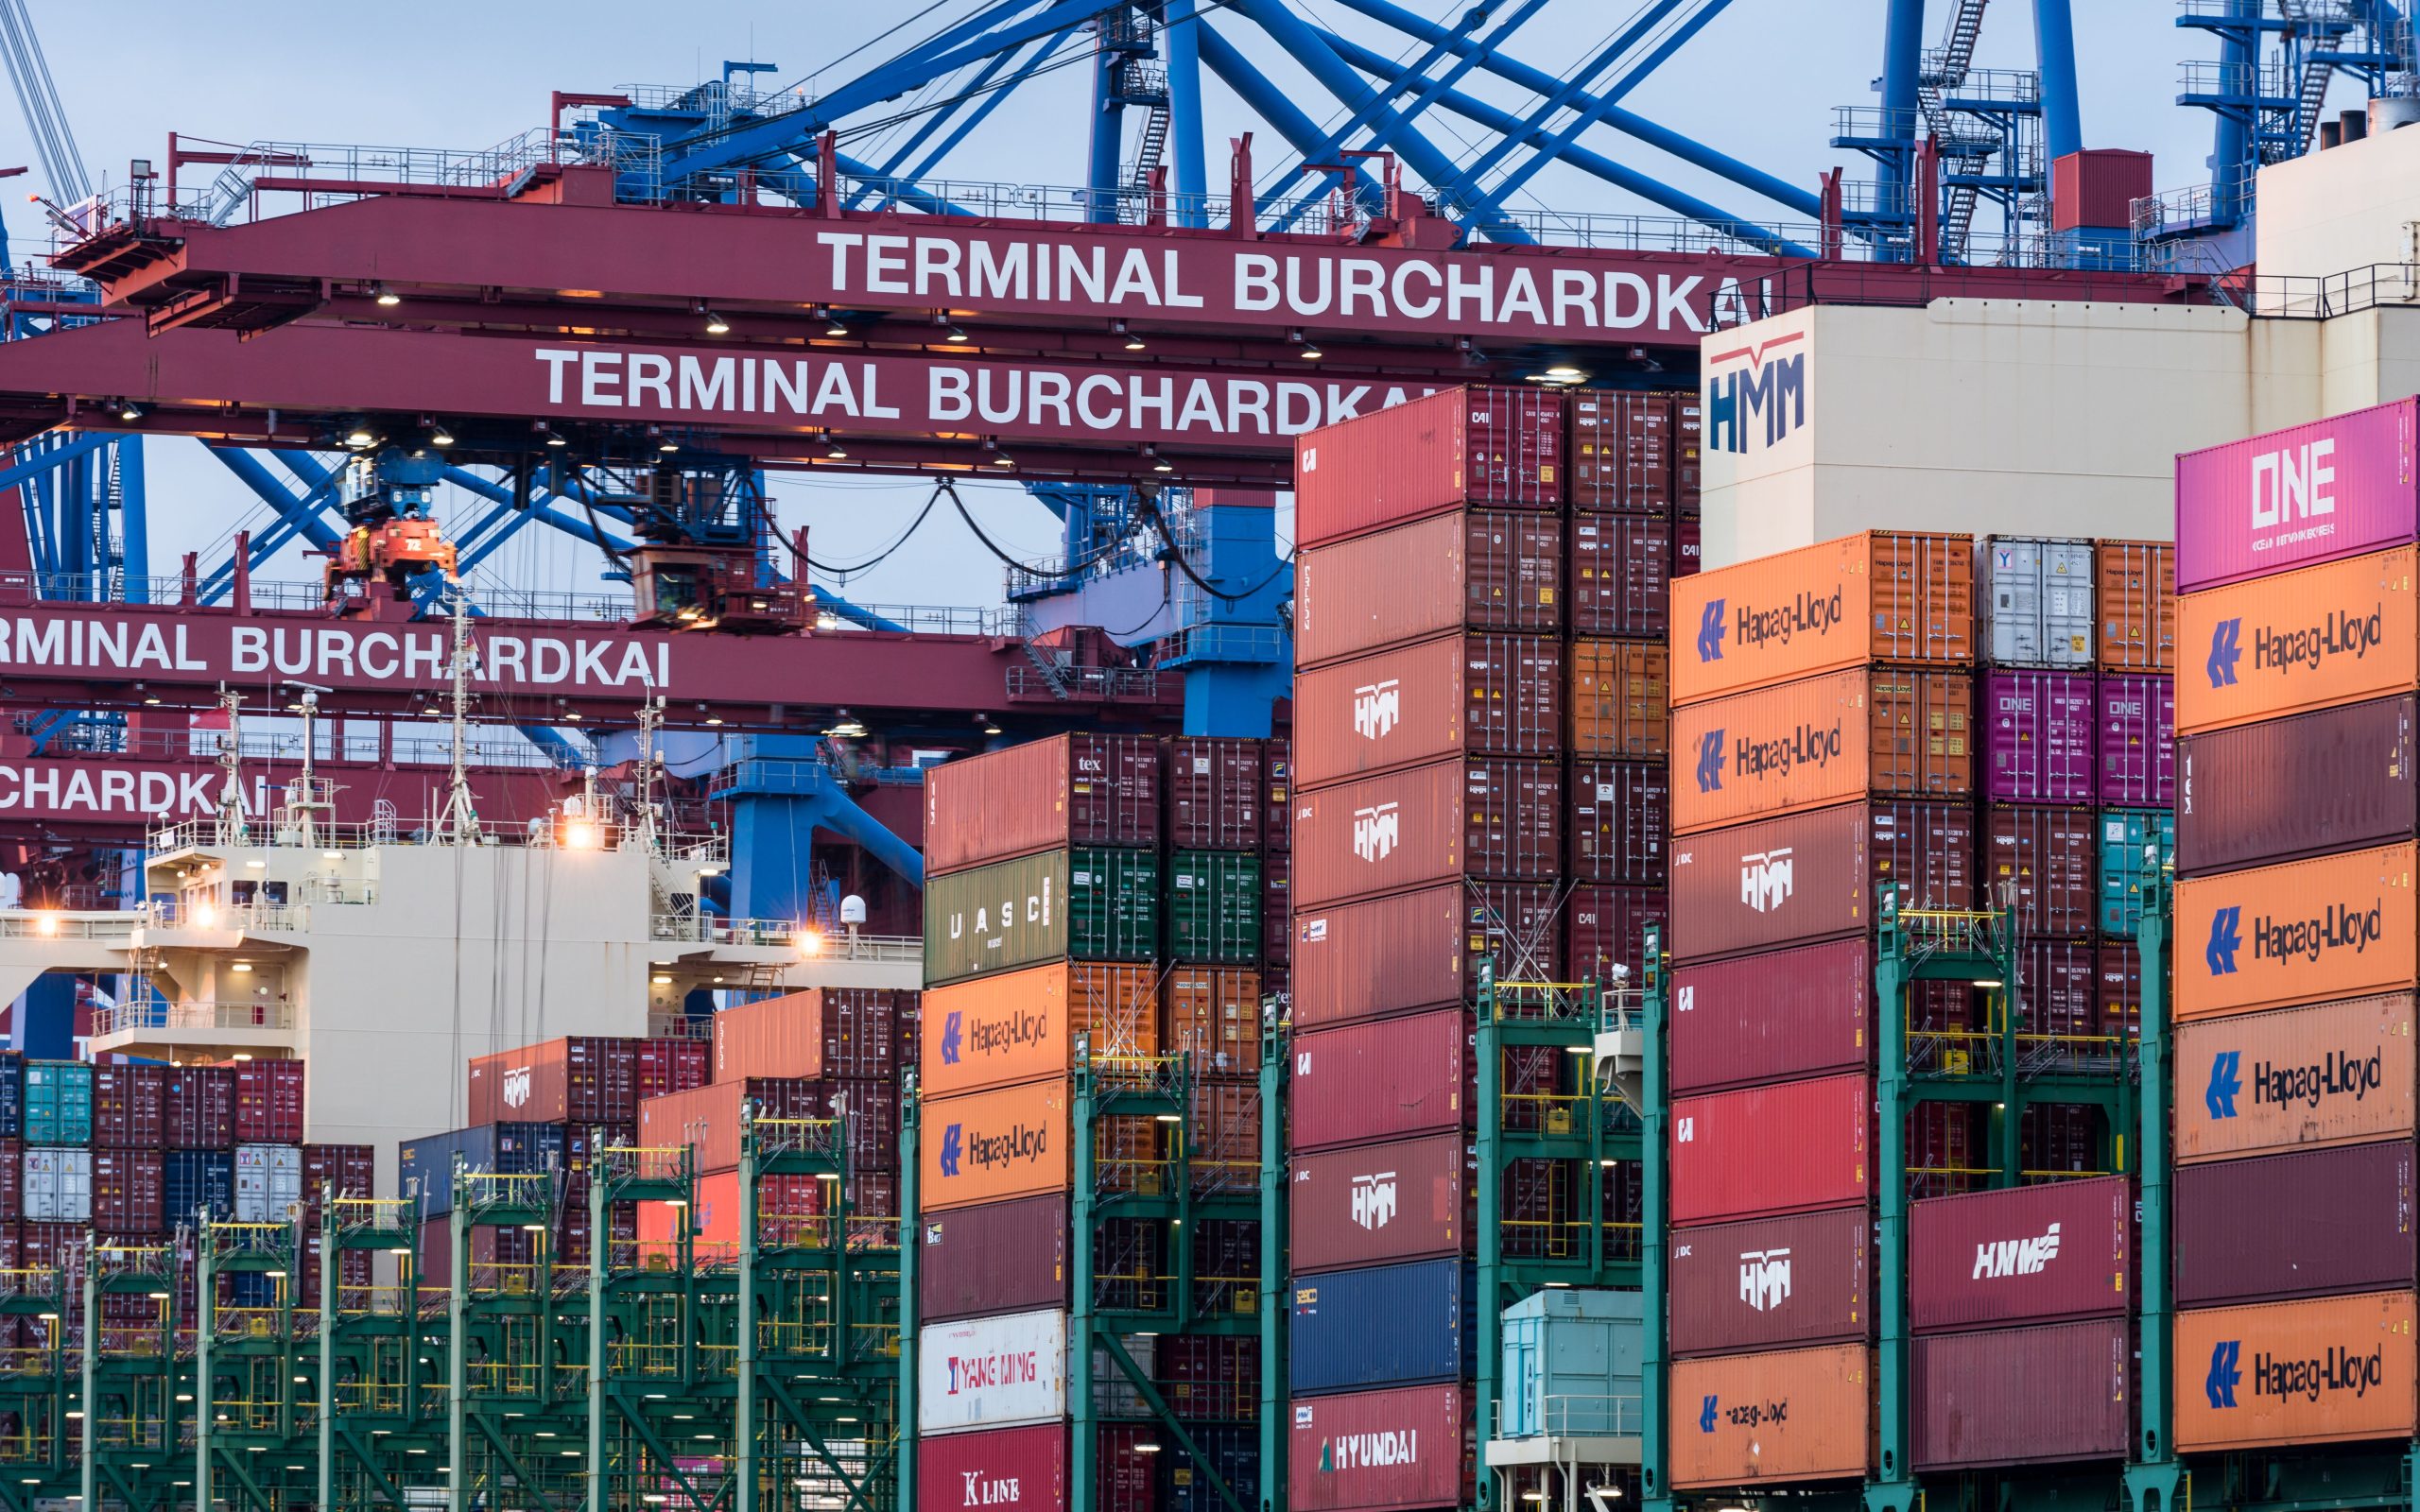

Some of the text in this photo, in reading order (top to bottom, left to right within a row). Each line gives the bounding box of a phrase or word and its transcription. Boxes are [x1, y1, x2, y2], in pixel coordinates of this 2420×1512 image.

[818, 232, 1203, 308] TERMINAL
[536, 349, 1436, 436] TERMINAL BURCHARDK
[1472, 412, 1490, 424] CAI
[1710, 352, 1804, 454] HMM
[2252, 438, 2335, 529] ONE
[1876, 559, 1912, 569] HapagLloyd
[2106, 569, 2144, 577] HapagLloyd
[0, 618, 206, 670] MINAL
[1737, 583, 1841, 649] Hapag-Lloyd
[2256, 602, 2381, 674] Hapag-Lloyd
[1355, 679, 1399, 740] HMM
[1876, 684, 1912, 693] HapagLloyd
[1999, 697, 2032, 712] ONE
[2109, 701, 2141, 715] ONE
[1079, 757, 1101, 771] tex
[1737, 717, 1841, 779] Hapag-Lloyd
[1355, 802, 1399, 863] HMM
[1741, 848, 1792, 913] HMM
[1579, 913, 1596, 924] CAI
[2256, 897, 2381, 966] Hapag-Lloyd
[971, 1005, 1046, 1054] Hapag-Lloyd
[2255, 1045, 2381, 1110] Hapag-Lloyd
[970, 1121, 1046, 1170] Hapag-Lloyd
[1353, 1172, 1396, 1229] HMM
[1740, 1248, 1790, 1311] HMM
[961, 1350, 1035, 1389] YANG MING
[2256, 1343, 2382, 1403] Hapag-Lloyd
[1336, 1429, 1417, 1470] HYUNDAI
[962, 1470, 1020, 1506] K LINE
